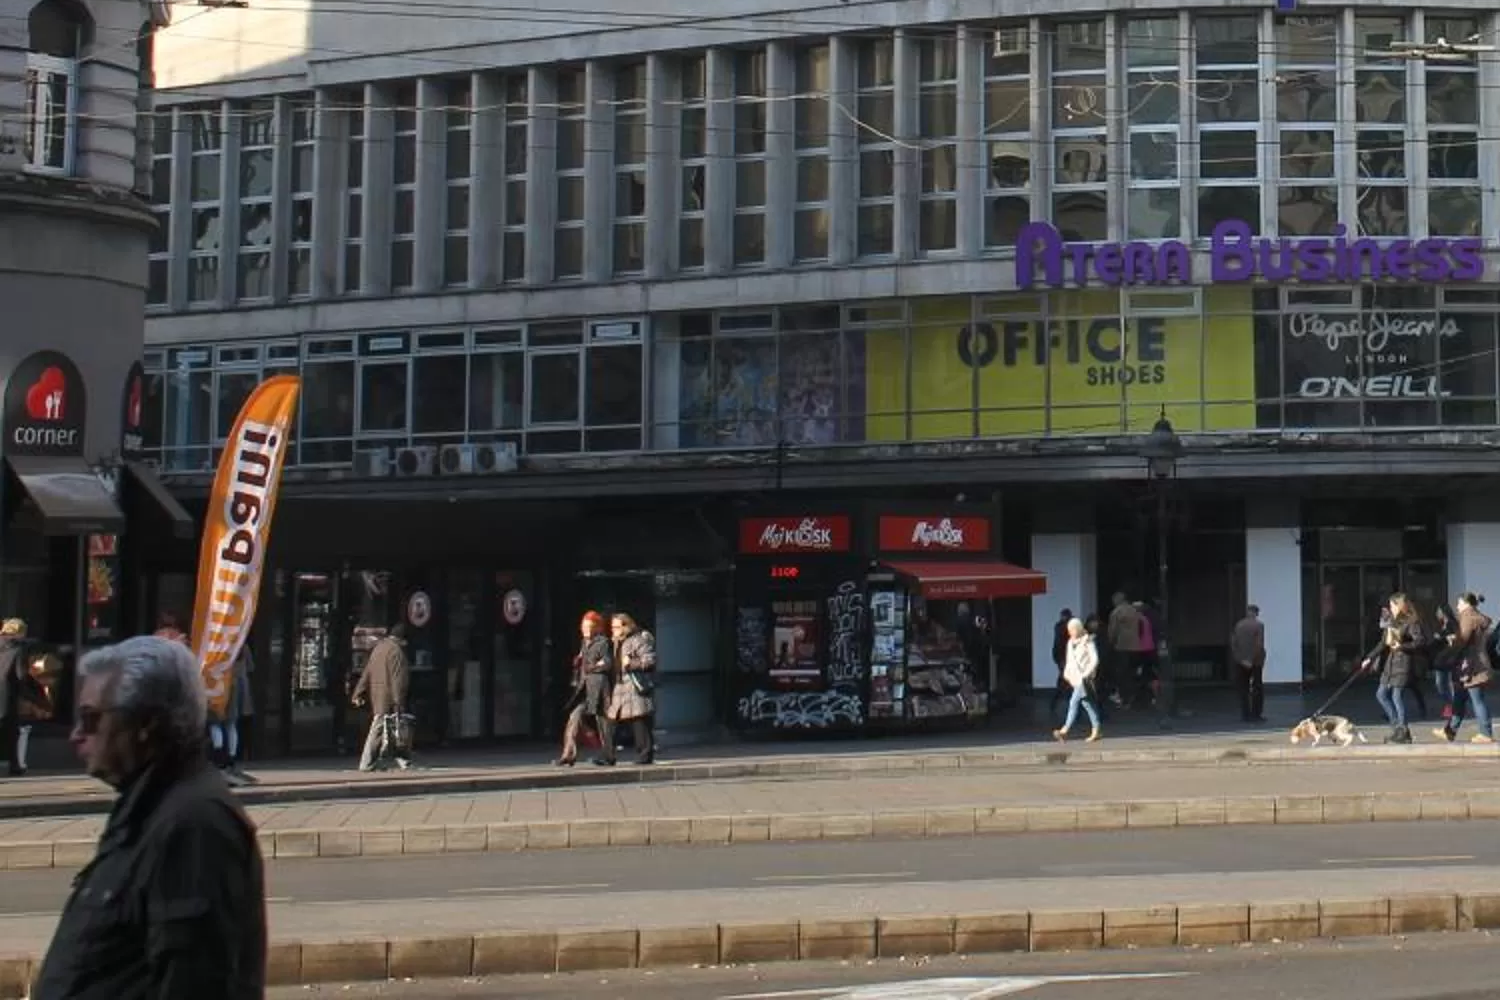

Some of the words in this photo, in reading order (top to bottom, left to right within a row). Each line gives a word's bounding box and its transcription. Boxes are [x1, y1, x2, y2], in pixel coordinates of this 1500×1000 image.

[957, 317, 1166, 368] OFFICE
[1087, 365, 1165, 385] SHOES
[1299, 375, 1452, 397] O'NEILL
[14, 426, 77, 446] corner
